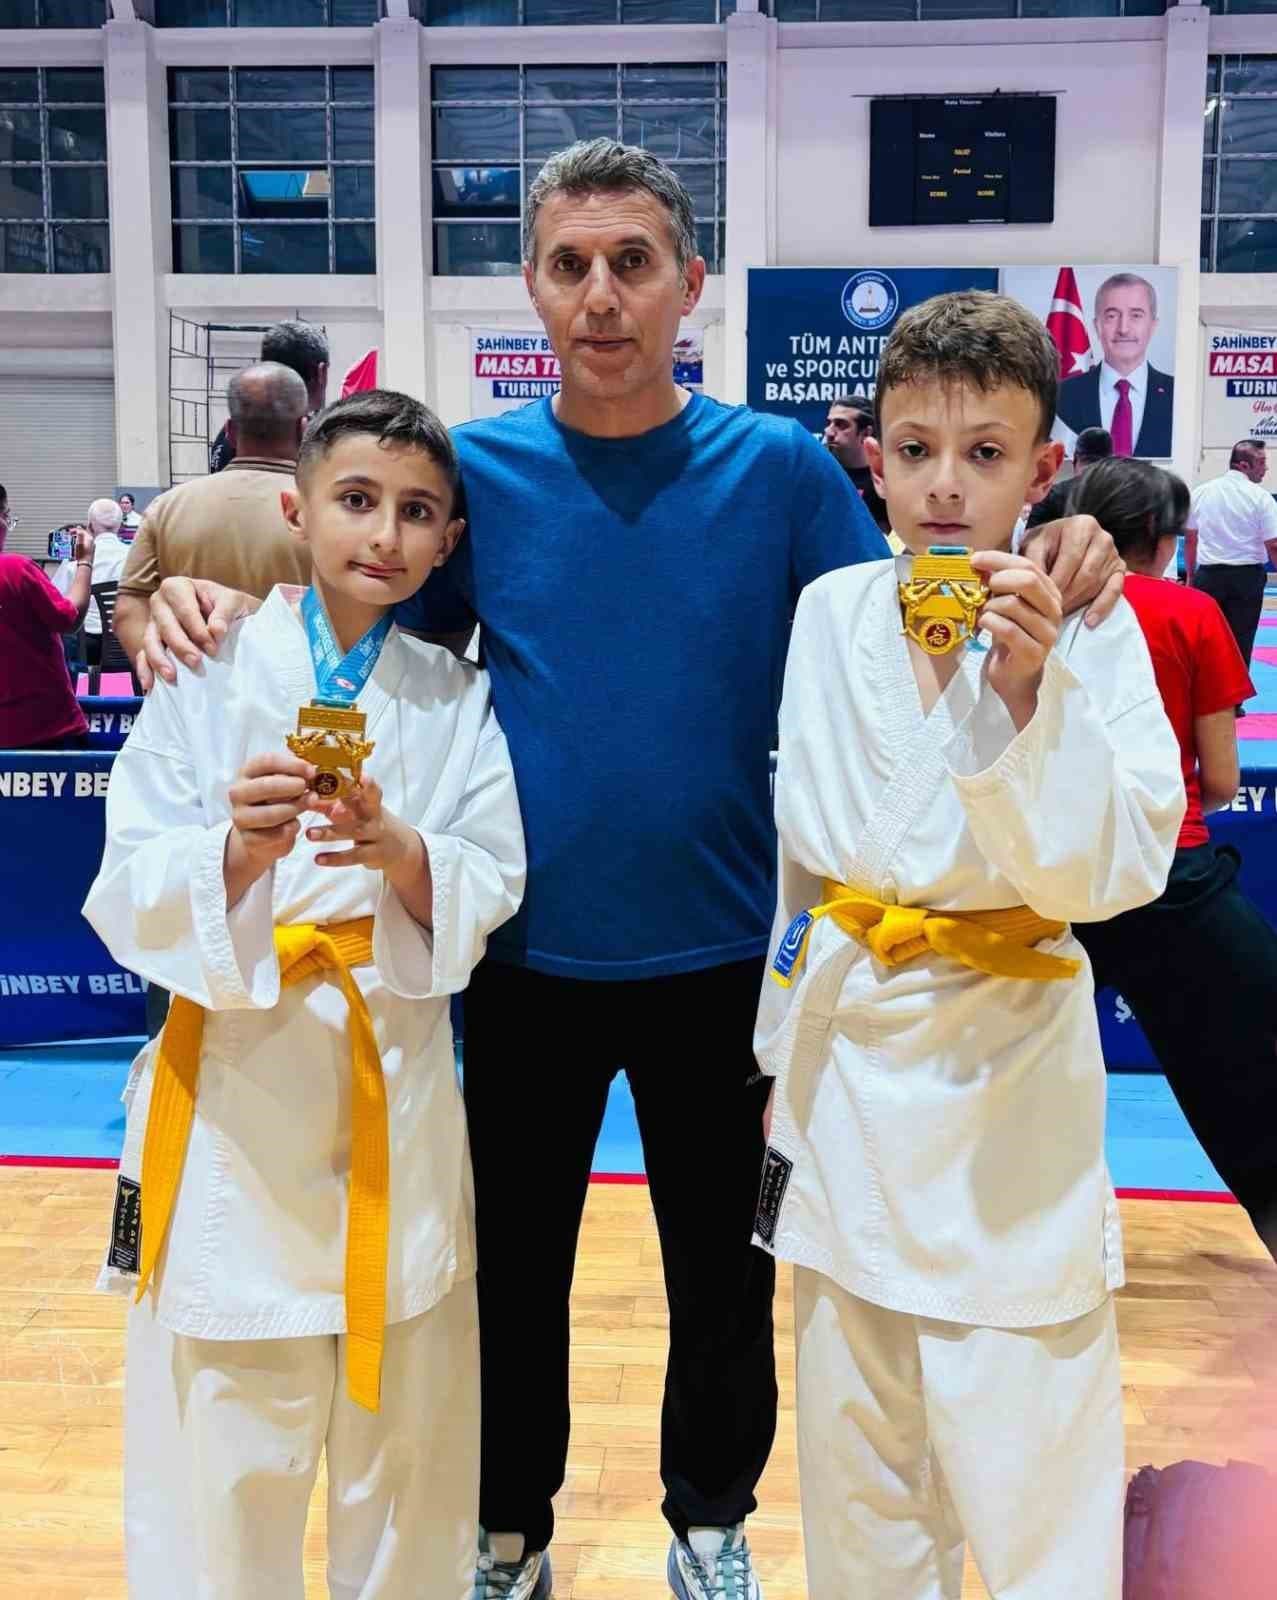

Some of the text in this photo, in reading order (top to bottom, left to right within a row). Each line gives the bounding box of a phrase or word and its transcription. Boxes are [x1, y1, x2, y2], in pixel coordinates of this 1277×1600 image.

[477, 336, 552, 352] ŞAHİNBEY B
[789, 333, 830, 354] TÜM
[1211, 334, 1276, 351] ŞAHİNBEY
[478, 356, 537, 376] MASA
[766, 363, 788, 378] ve
[1212, 354, 1274, 374] MASA
[88, 713, 137, 734] EY B
[0, 772, 67, 797] NBEY
[1217, 786, 1267, 812] EY
